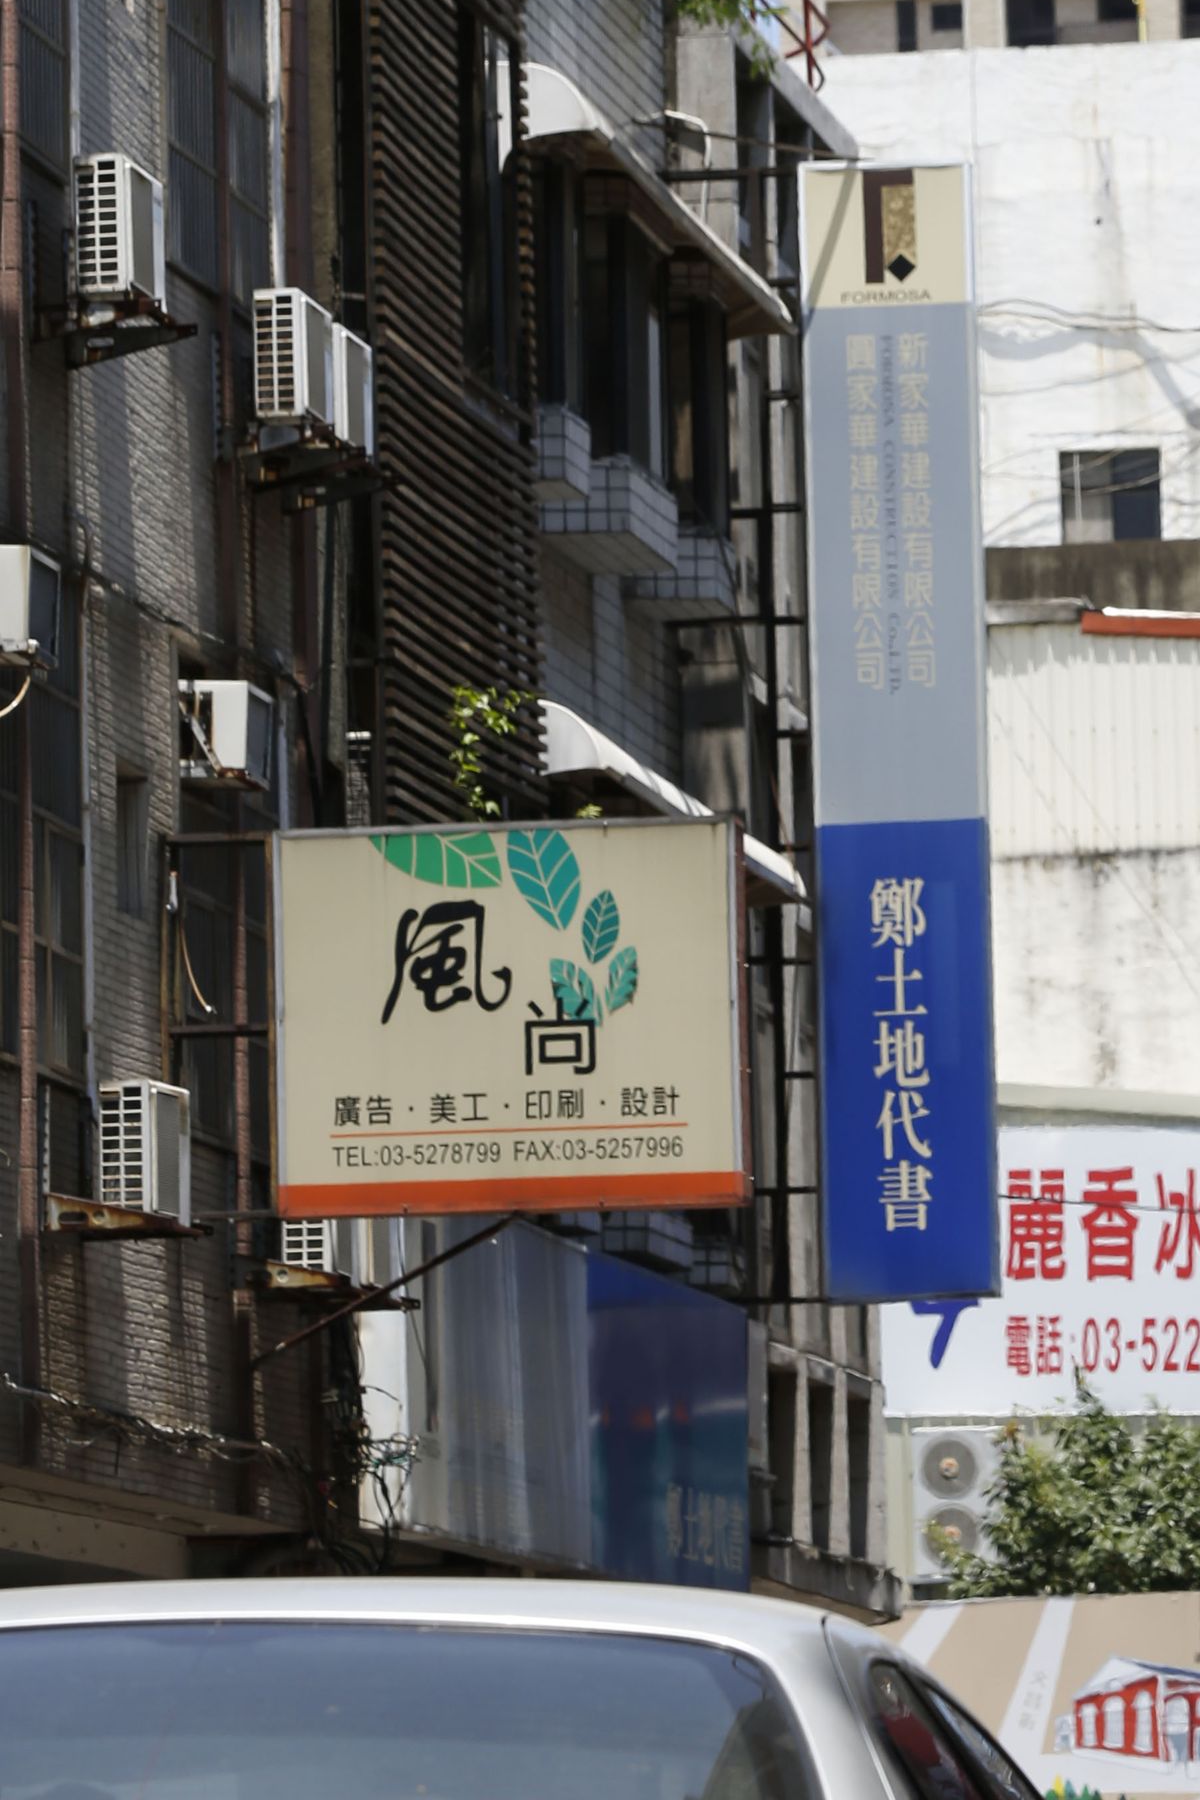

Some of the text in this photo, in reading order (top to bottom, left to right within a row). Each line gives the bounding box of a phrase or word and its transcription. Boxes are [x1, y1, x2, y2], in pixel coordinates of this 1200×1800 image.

[840, 288, 932, 304] FORMOSA
[897, 332, 937, 688] 新家華建設有限公司
[870, 878, 932, 1232] 鄭土地代書
[332, 1136, 684, 1168] TEL:03-5278799 FAX:03-5257996
